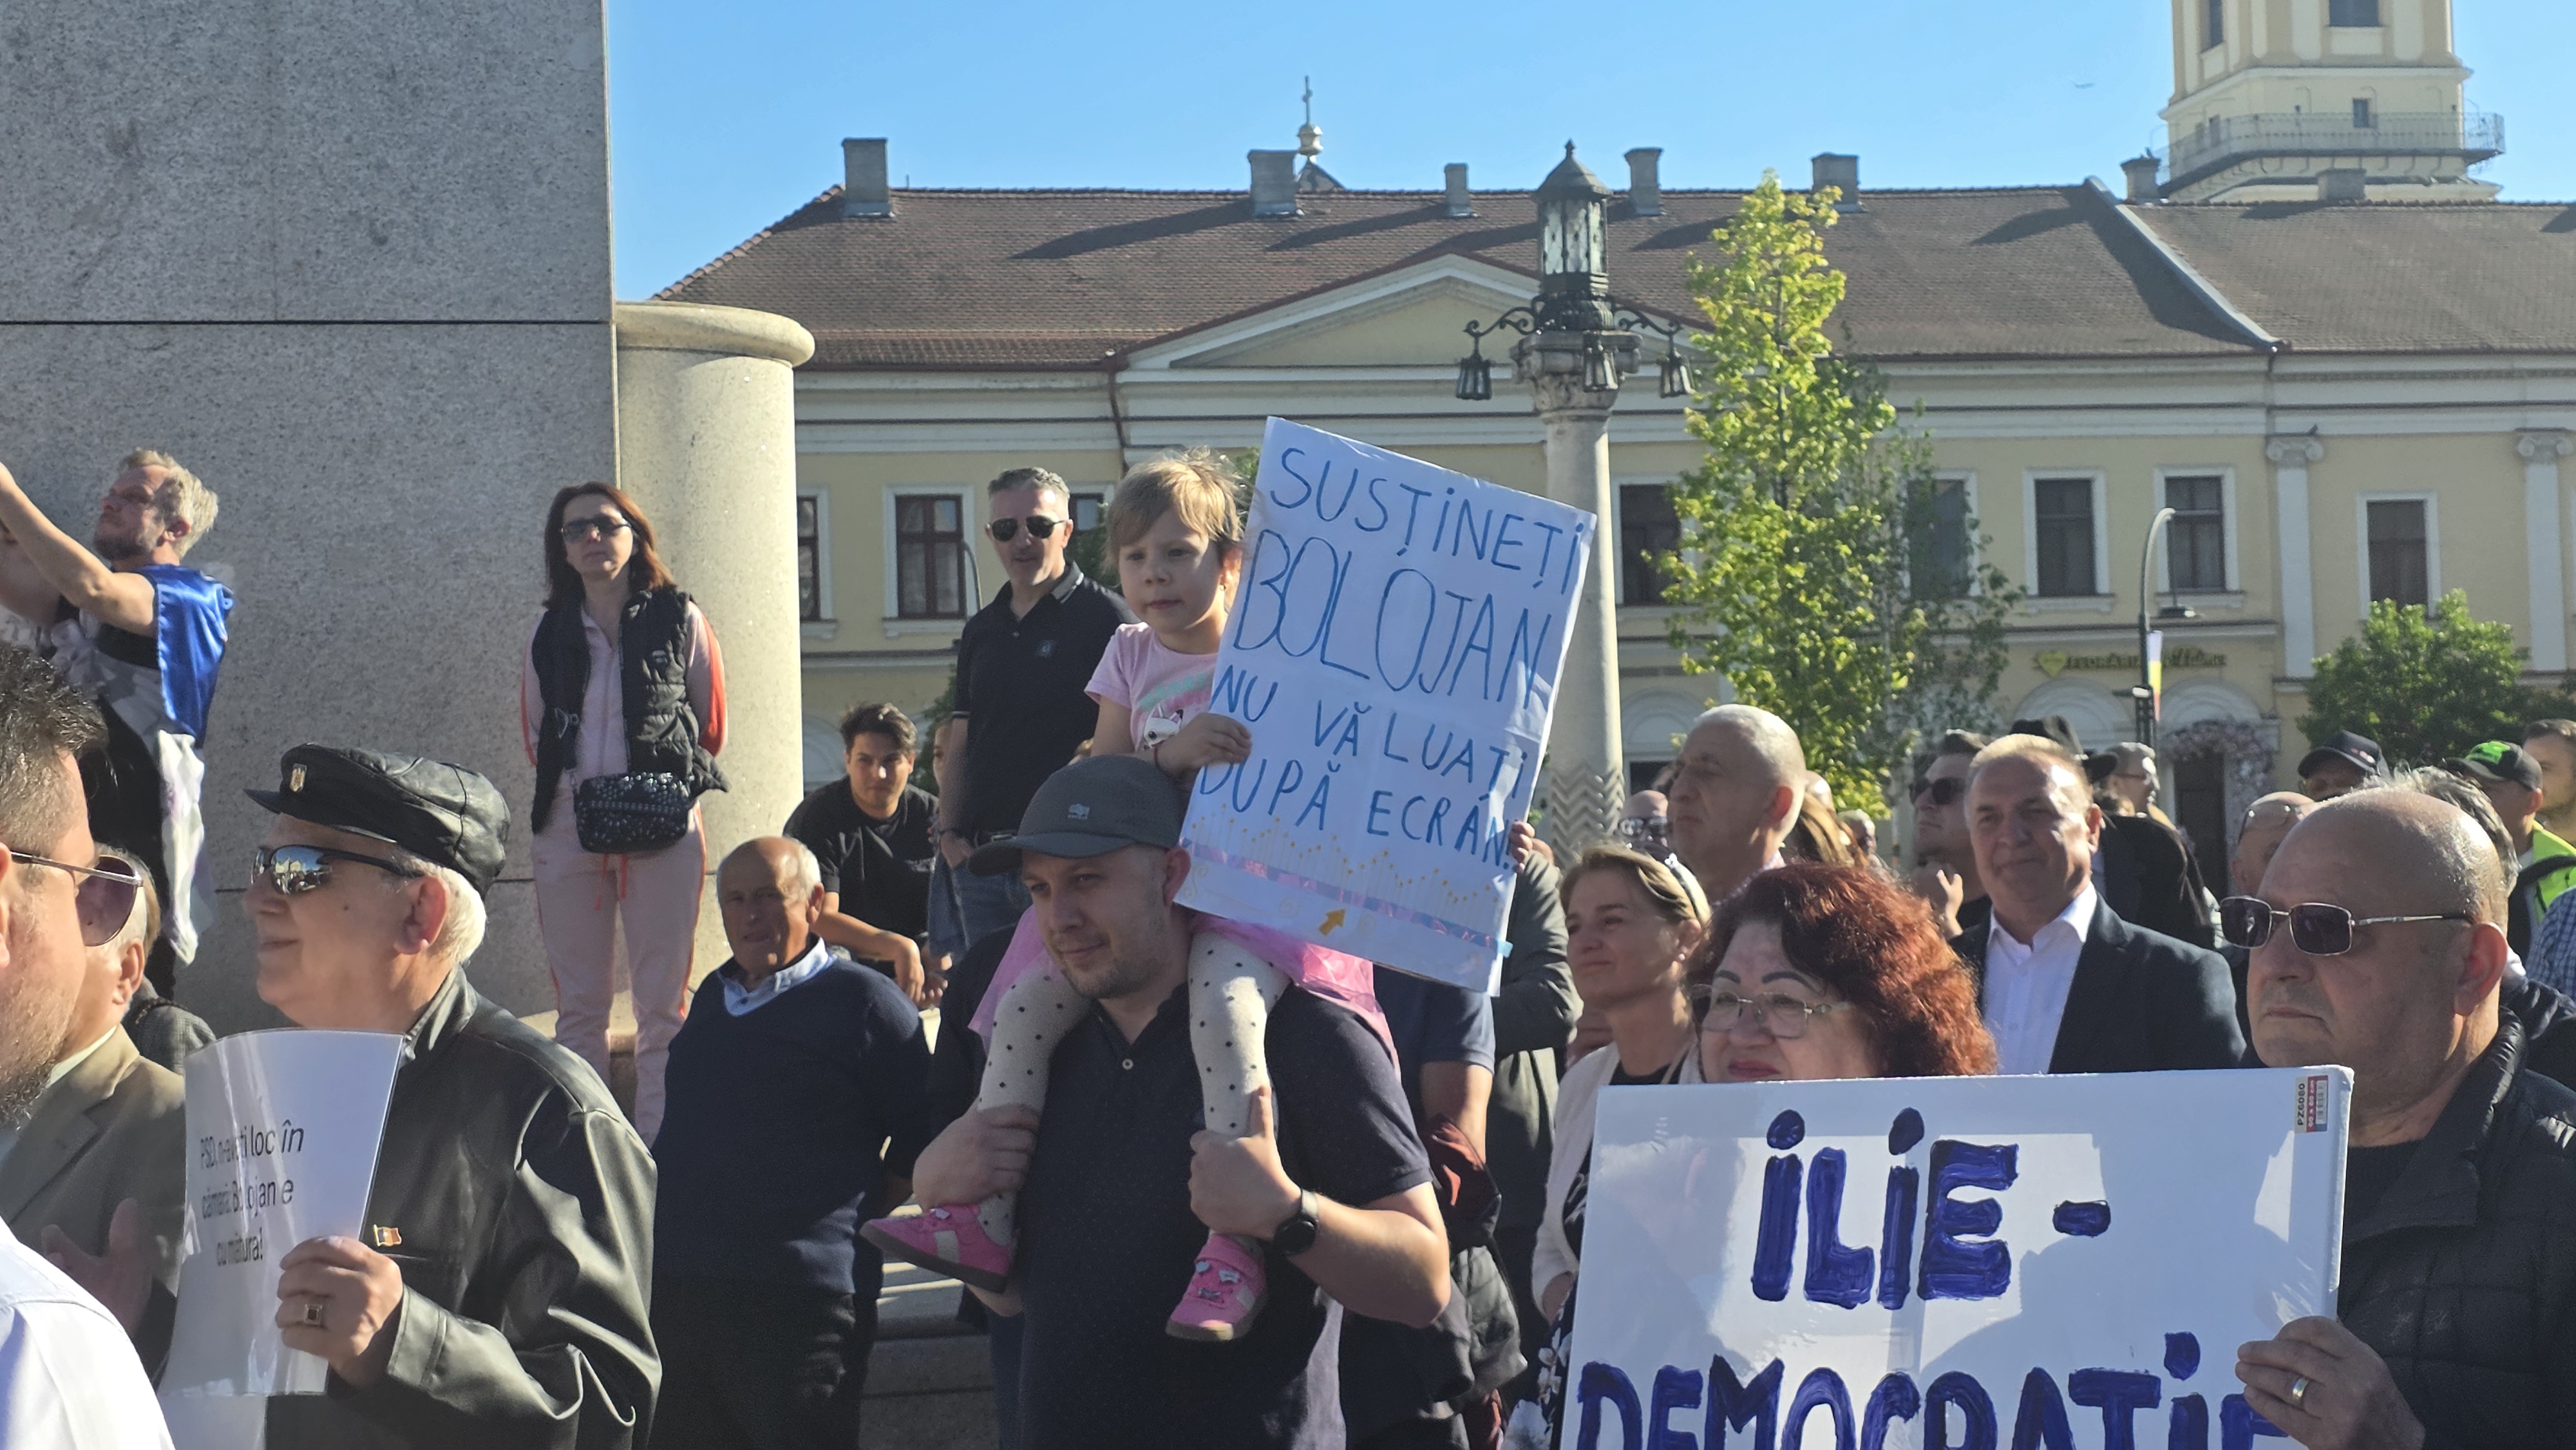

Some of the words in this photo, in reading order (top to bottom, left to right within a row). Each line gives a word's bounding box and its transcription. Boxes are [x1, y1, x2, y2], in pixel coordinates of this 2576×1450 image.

[1233, 529, 1552, 710] BOLOJAN
[1209, 664, 1278, 722] NU
[1314, 699, 1373, 757] VĂ
[251, 1125, 276, 1157] loc
[281, 1119, 304, 1154] în
[232, 1176, 276, 1218] Bojan
[281, 1179, 294, 1205] e
